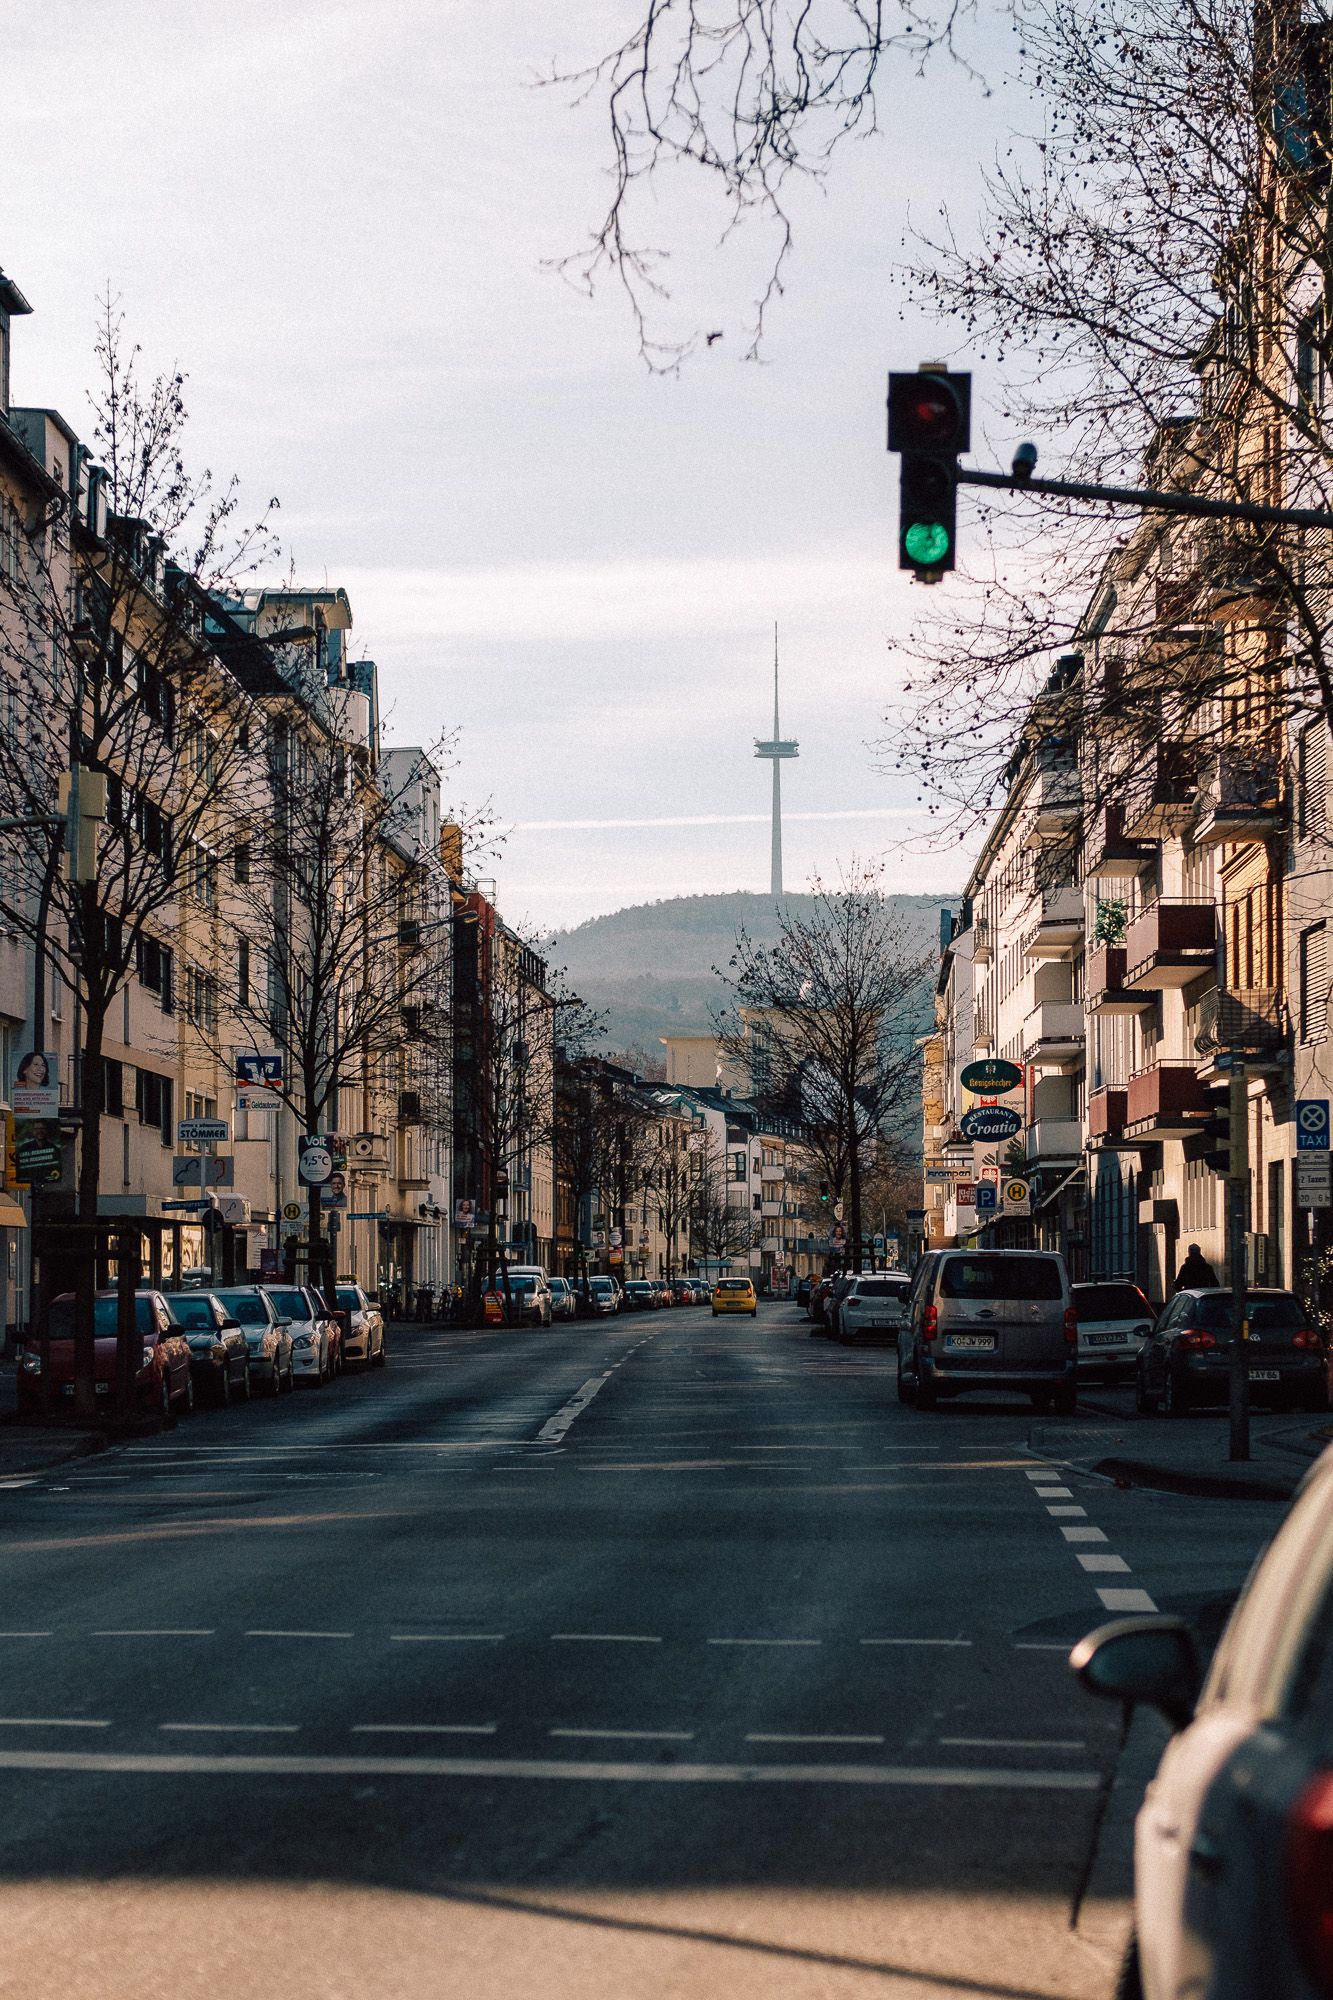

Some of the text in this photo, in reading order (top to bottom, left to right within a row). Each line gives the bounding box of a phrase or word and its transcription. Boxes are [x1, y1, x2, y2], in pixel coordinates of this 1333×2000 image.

[969, 1108, 1013, 1122] RESTAURANT
[180, 1128, 226, 1138] STÖMMER
[966, 1121, 1017, 1136] Croatia
[305, 1136, 327, 1147] Volt
[1300, 1135, 1327, 1146] TAXI
[303, 1154, 329, 1167] 1,5°C
[1307, 1175, 1327, 1183] Taxen
[1012, 1187, 1022, 1197] H
[981, 1190, 991, 1206] P
[1300, 1194, 1309, 1202] 20
[287, 1207, 297, 1217] H
[977, 1338, 992, 1346] 999
